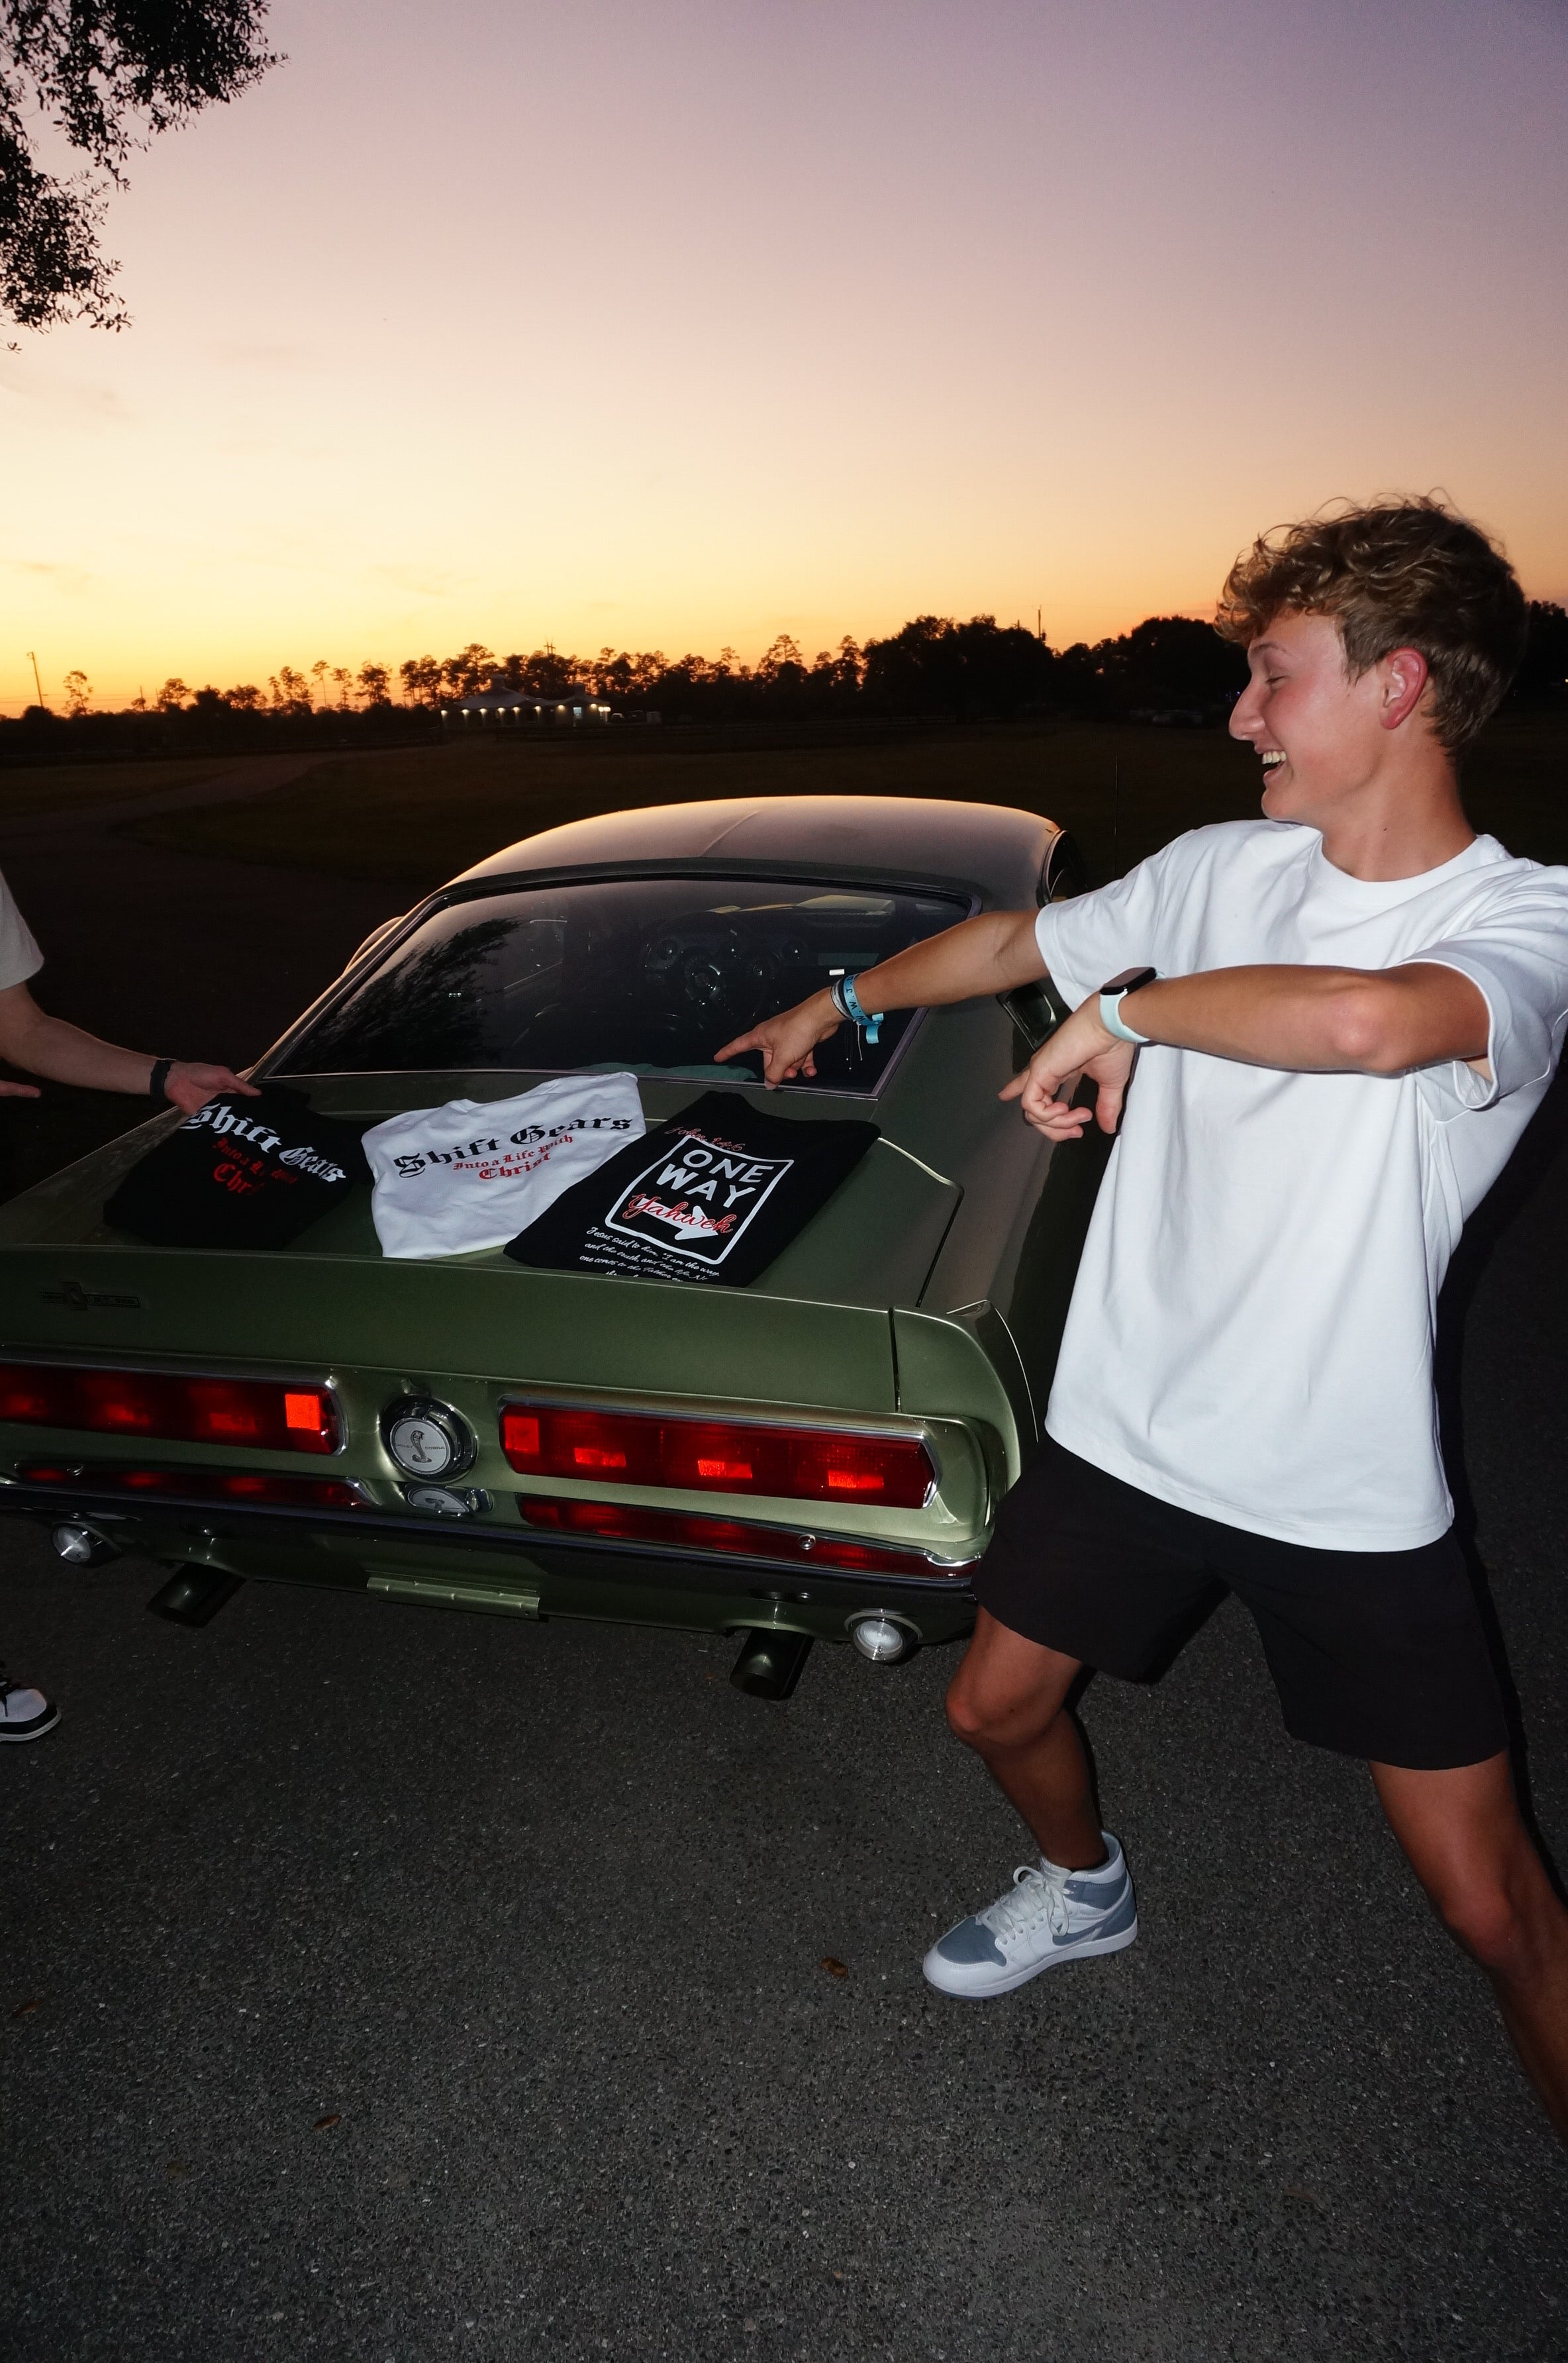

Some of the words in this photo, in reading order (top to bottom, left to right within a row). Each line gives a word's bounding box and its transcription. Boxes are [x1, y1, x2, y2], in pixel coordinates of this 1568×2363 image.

[179, 1103, 281, 1154] Shift
[279, 1146, 346, 1182] Gears
[393, 1138, 501, 1178] Shift
[510, 1117, 632, 1144] Gears
[664, 1127, 707, 1141] John
[453, 1160, 489, 1170] Into
[503, 1150, 535, 1164] Life
[537, 1134, 573, 1154] With
[479, 1152, 551, 1180] Christ
[683, 1149, 774, 1183] ONE
[656, 1163, 756, 1208] WAY
[622, 1193, 737, 1234] Yahweh
[586, 1227, 613, 1240] Jesus
[611, 1237, 636, 1248] said
[640, 1246, 658, 1257] him,
[616, 1252, 641, 1262] truth,
